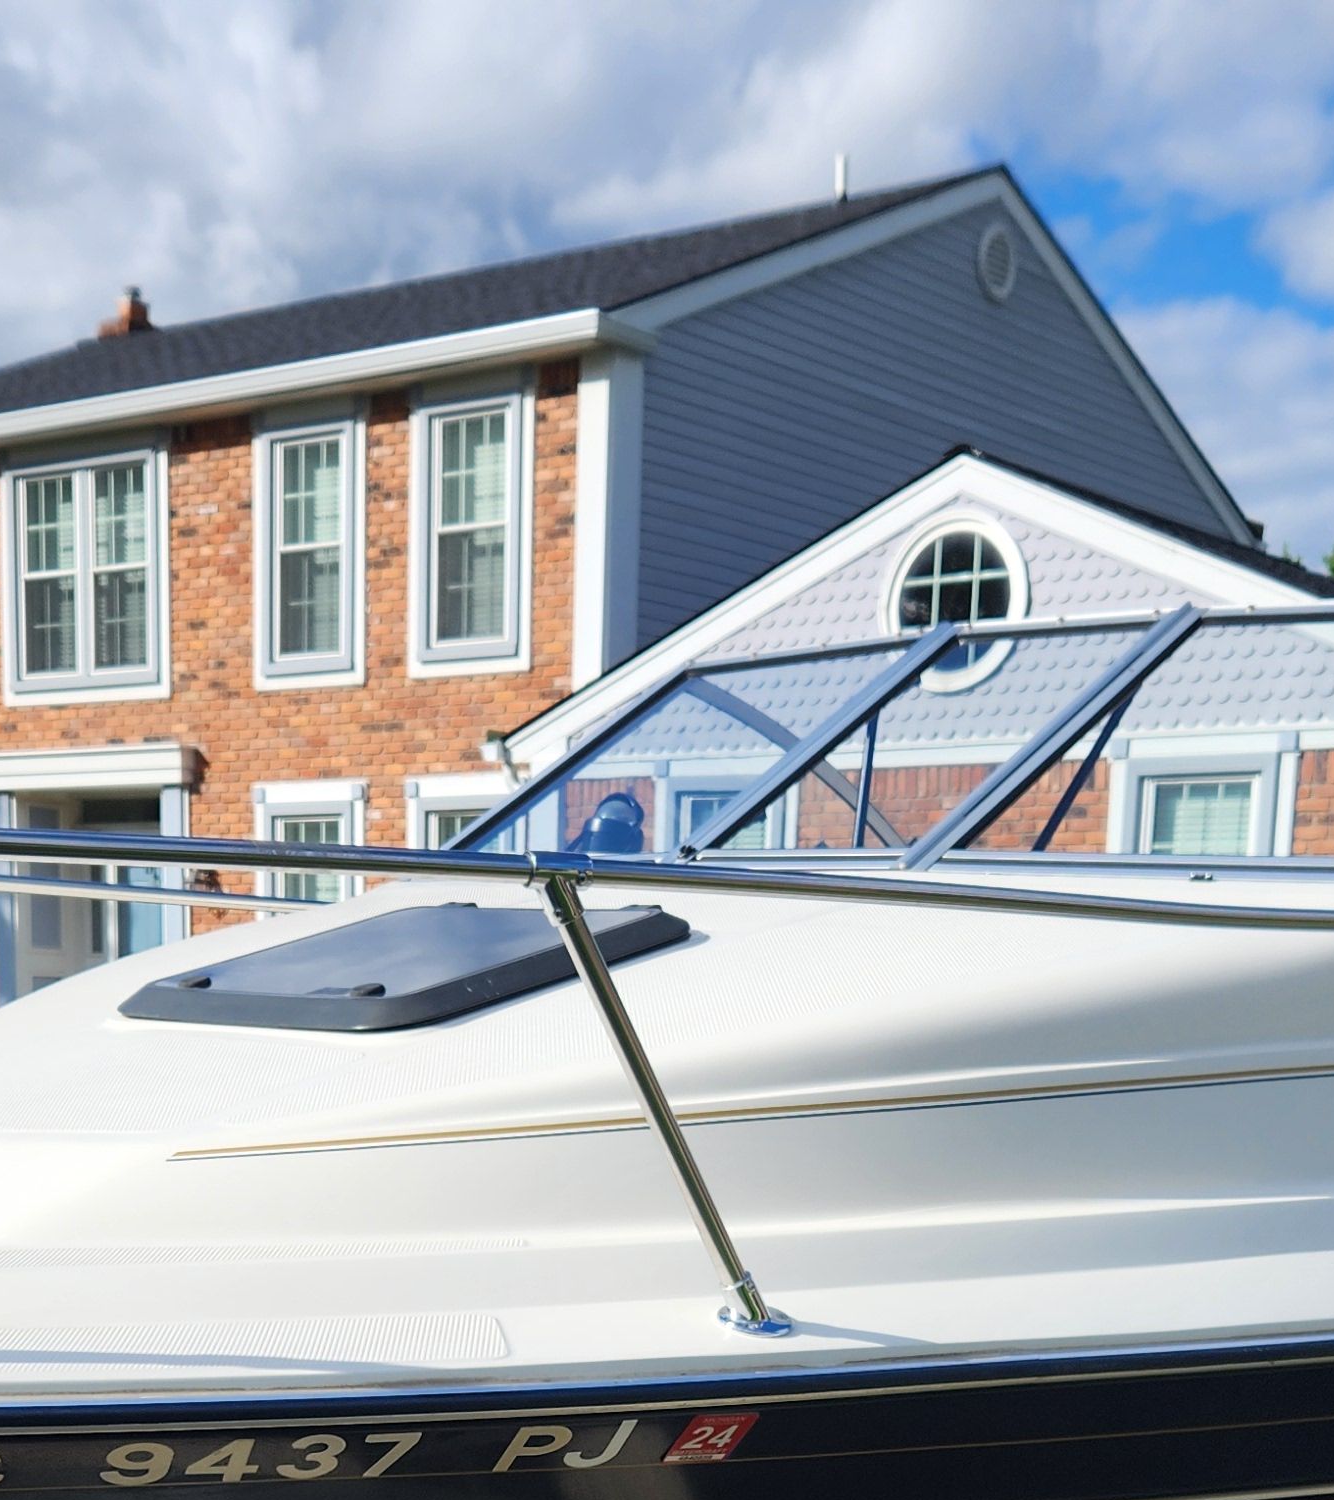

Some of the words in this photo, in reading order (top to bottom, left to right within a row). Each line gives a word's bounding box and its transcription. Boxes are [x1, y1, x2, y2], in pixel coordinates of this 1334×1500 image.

[99, 1432, 423, 1486] 9437
[492, 1419, 639, 1473] PJ
[680, 1425, 739, 1450] 24
